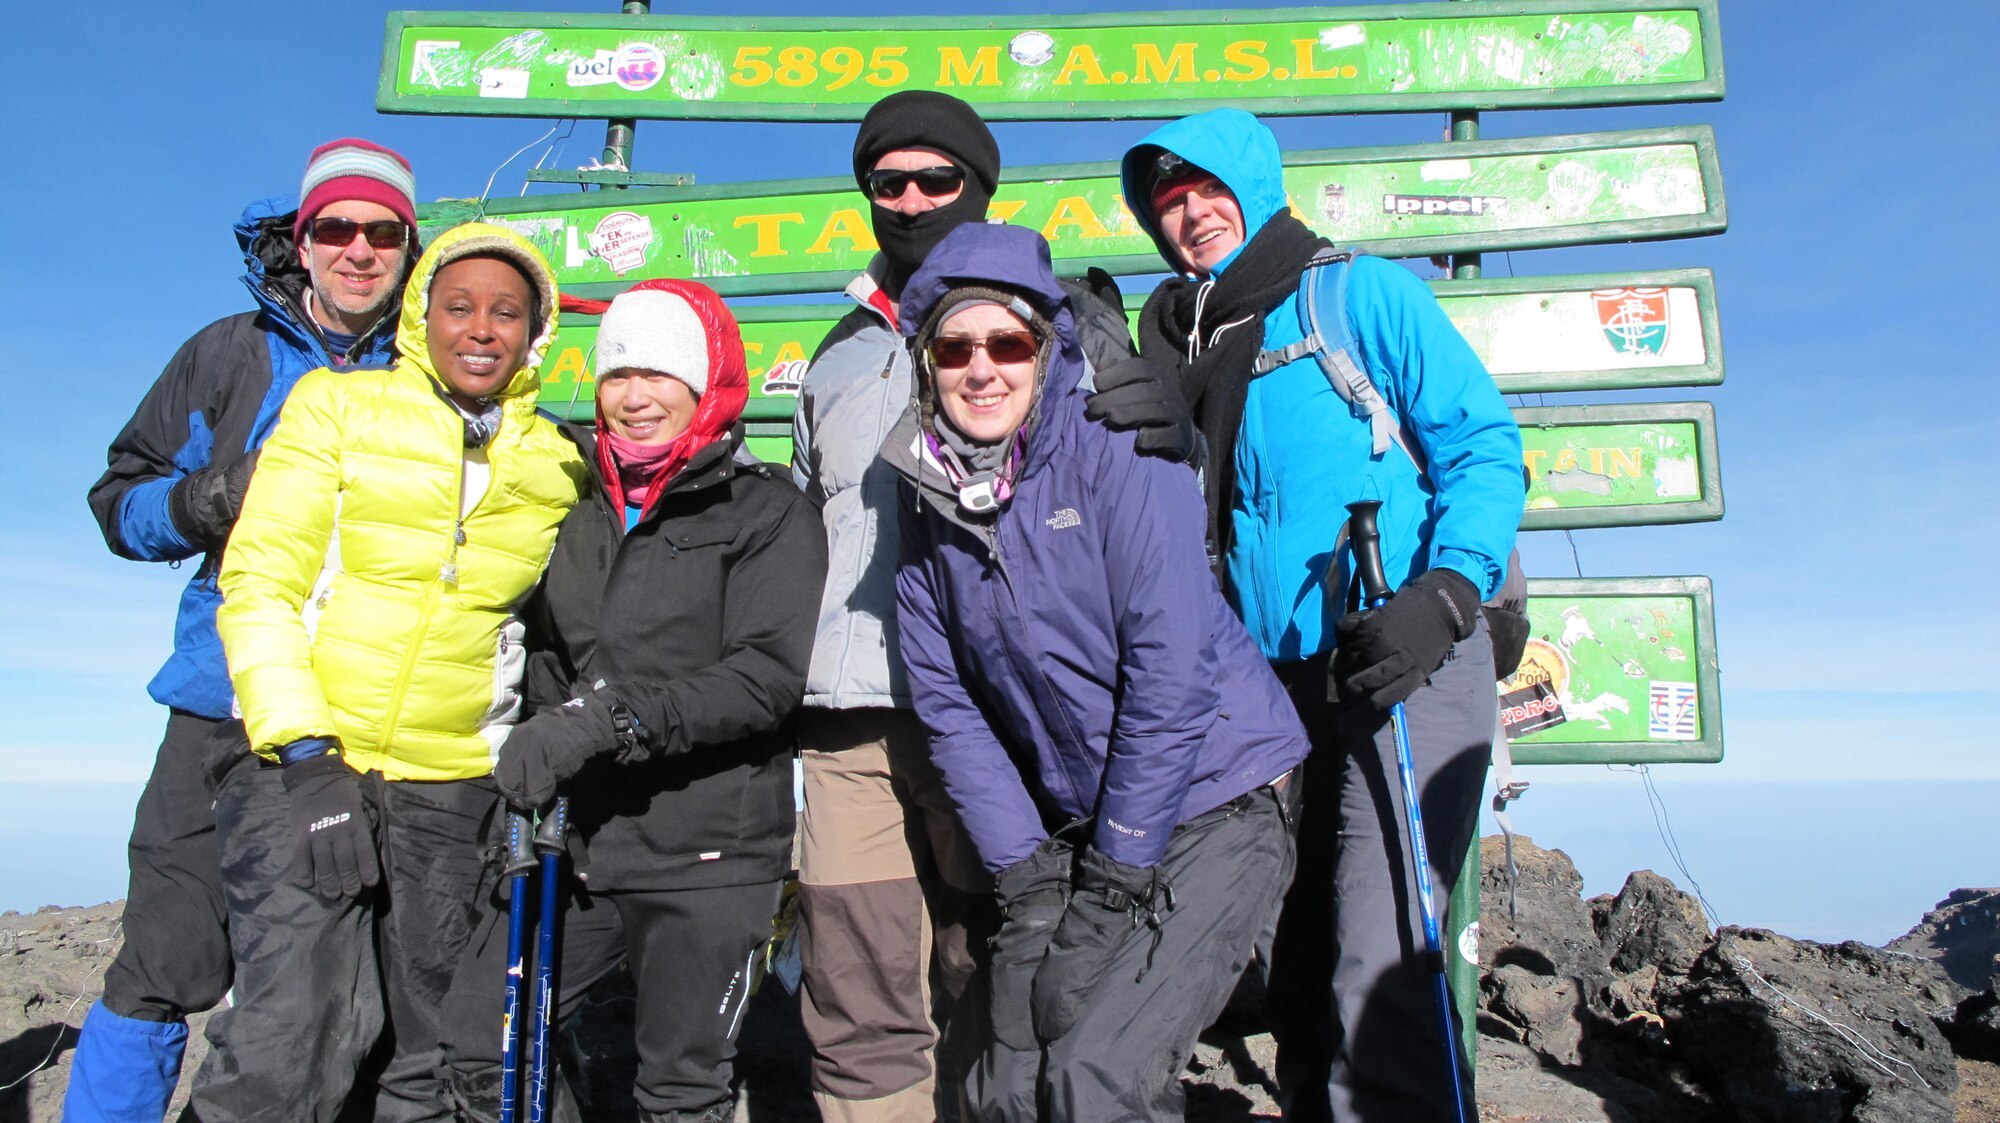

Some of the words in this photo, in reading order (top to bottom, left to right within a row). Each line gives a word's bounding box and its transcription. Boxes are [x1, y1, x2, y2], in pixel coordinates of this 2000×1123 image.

[729, 46, 909, 91] 5895
[935, 46, 1003, 87] M
[1052, 39, 1358, 85] A.M.S.L.
[1054, 509, 1067, 517] THE
[1045, 516, 1068, 526] NORTH
[1052, 522, 1069, 530] FACE
